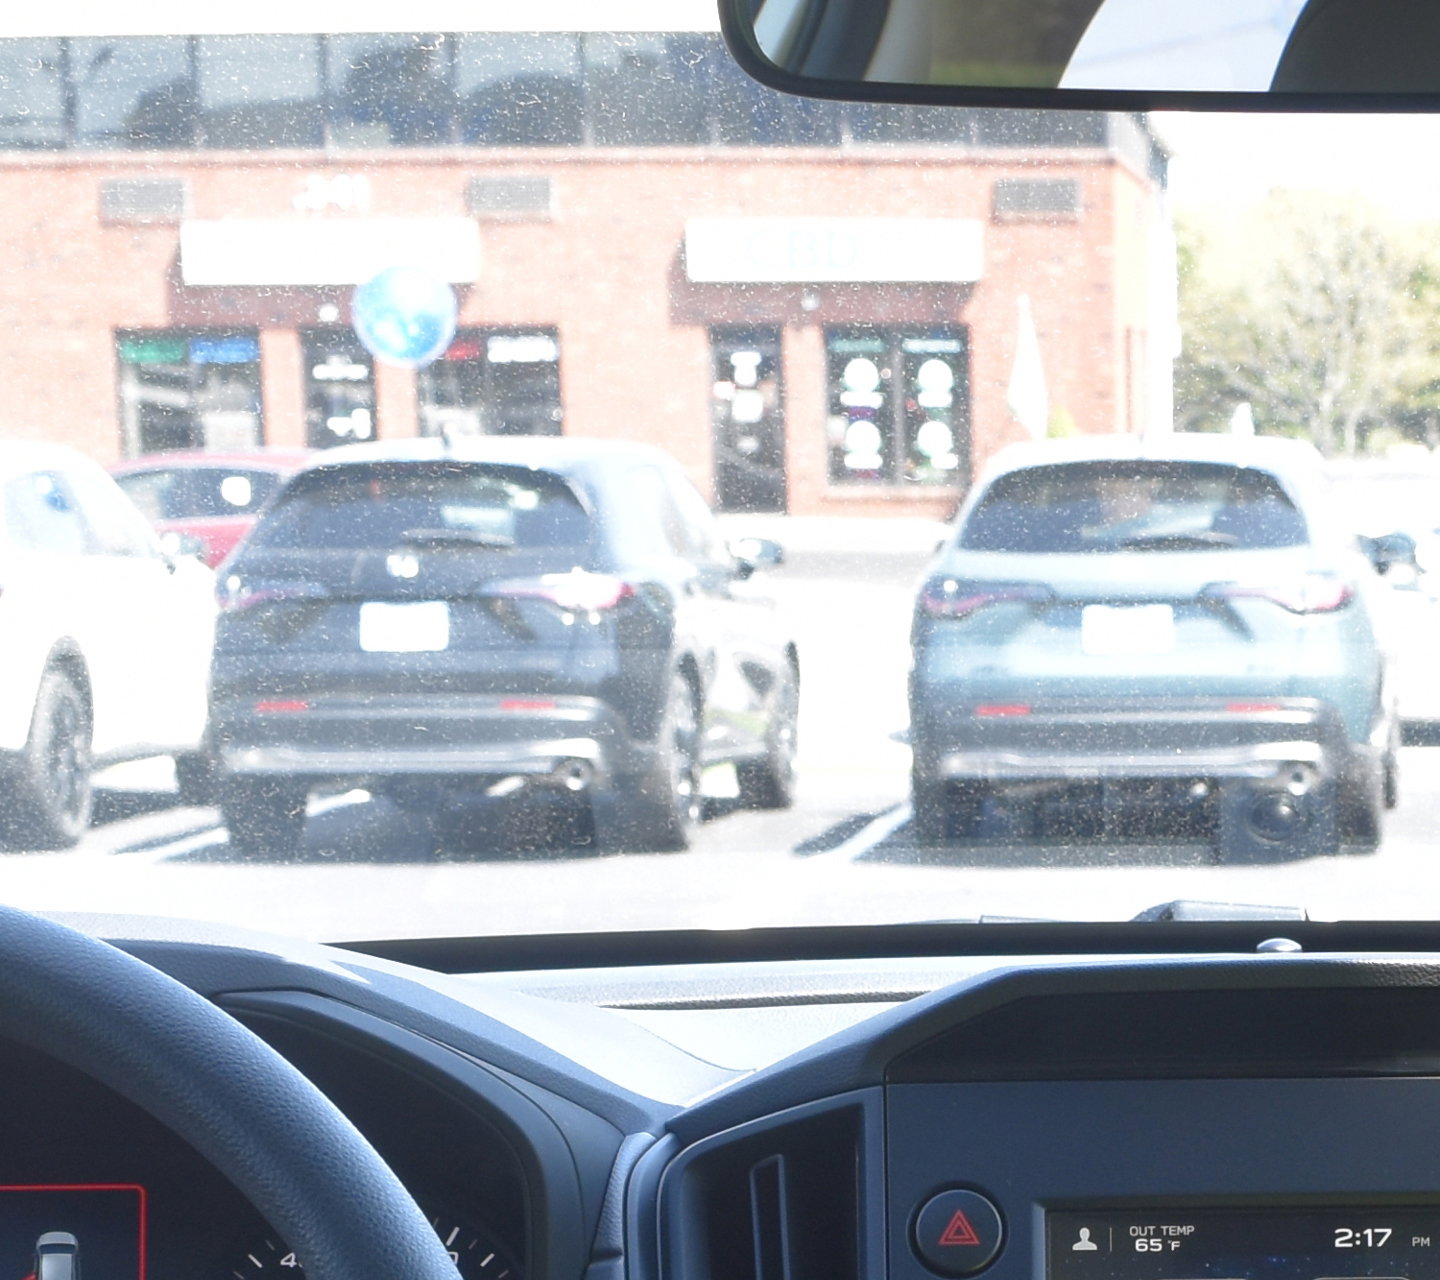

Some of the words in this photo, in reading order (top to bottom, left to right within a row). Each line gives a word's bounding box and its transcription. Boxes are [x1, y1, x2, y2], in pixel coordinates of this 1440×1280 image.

[1129, 1226, 1156, 1237] OUT
[1161, 1225, 1195, 1237] TEMP
[1334, 1228, 1393, 1248] 2:17
[1412, 1236, 1430, 1247] PM
[1135, 1239, 1162, 1252] 65
